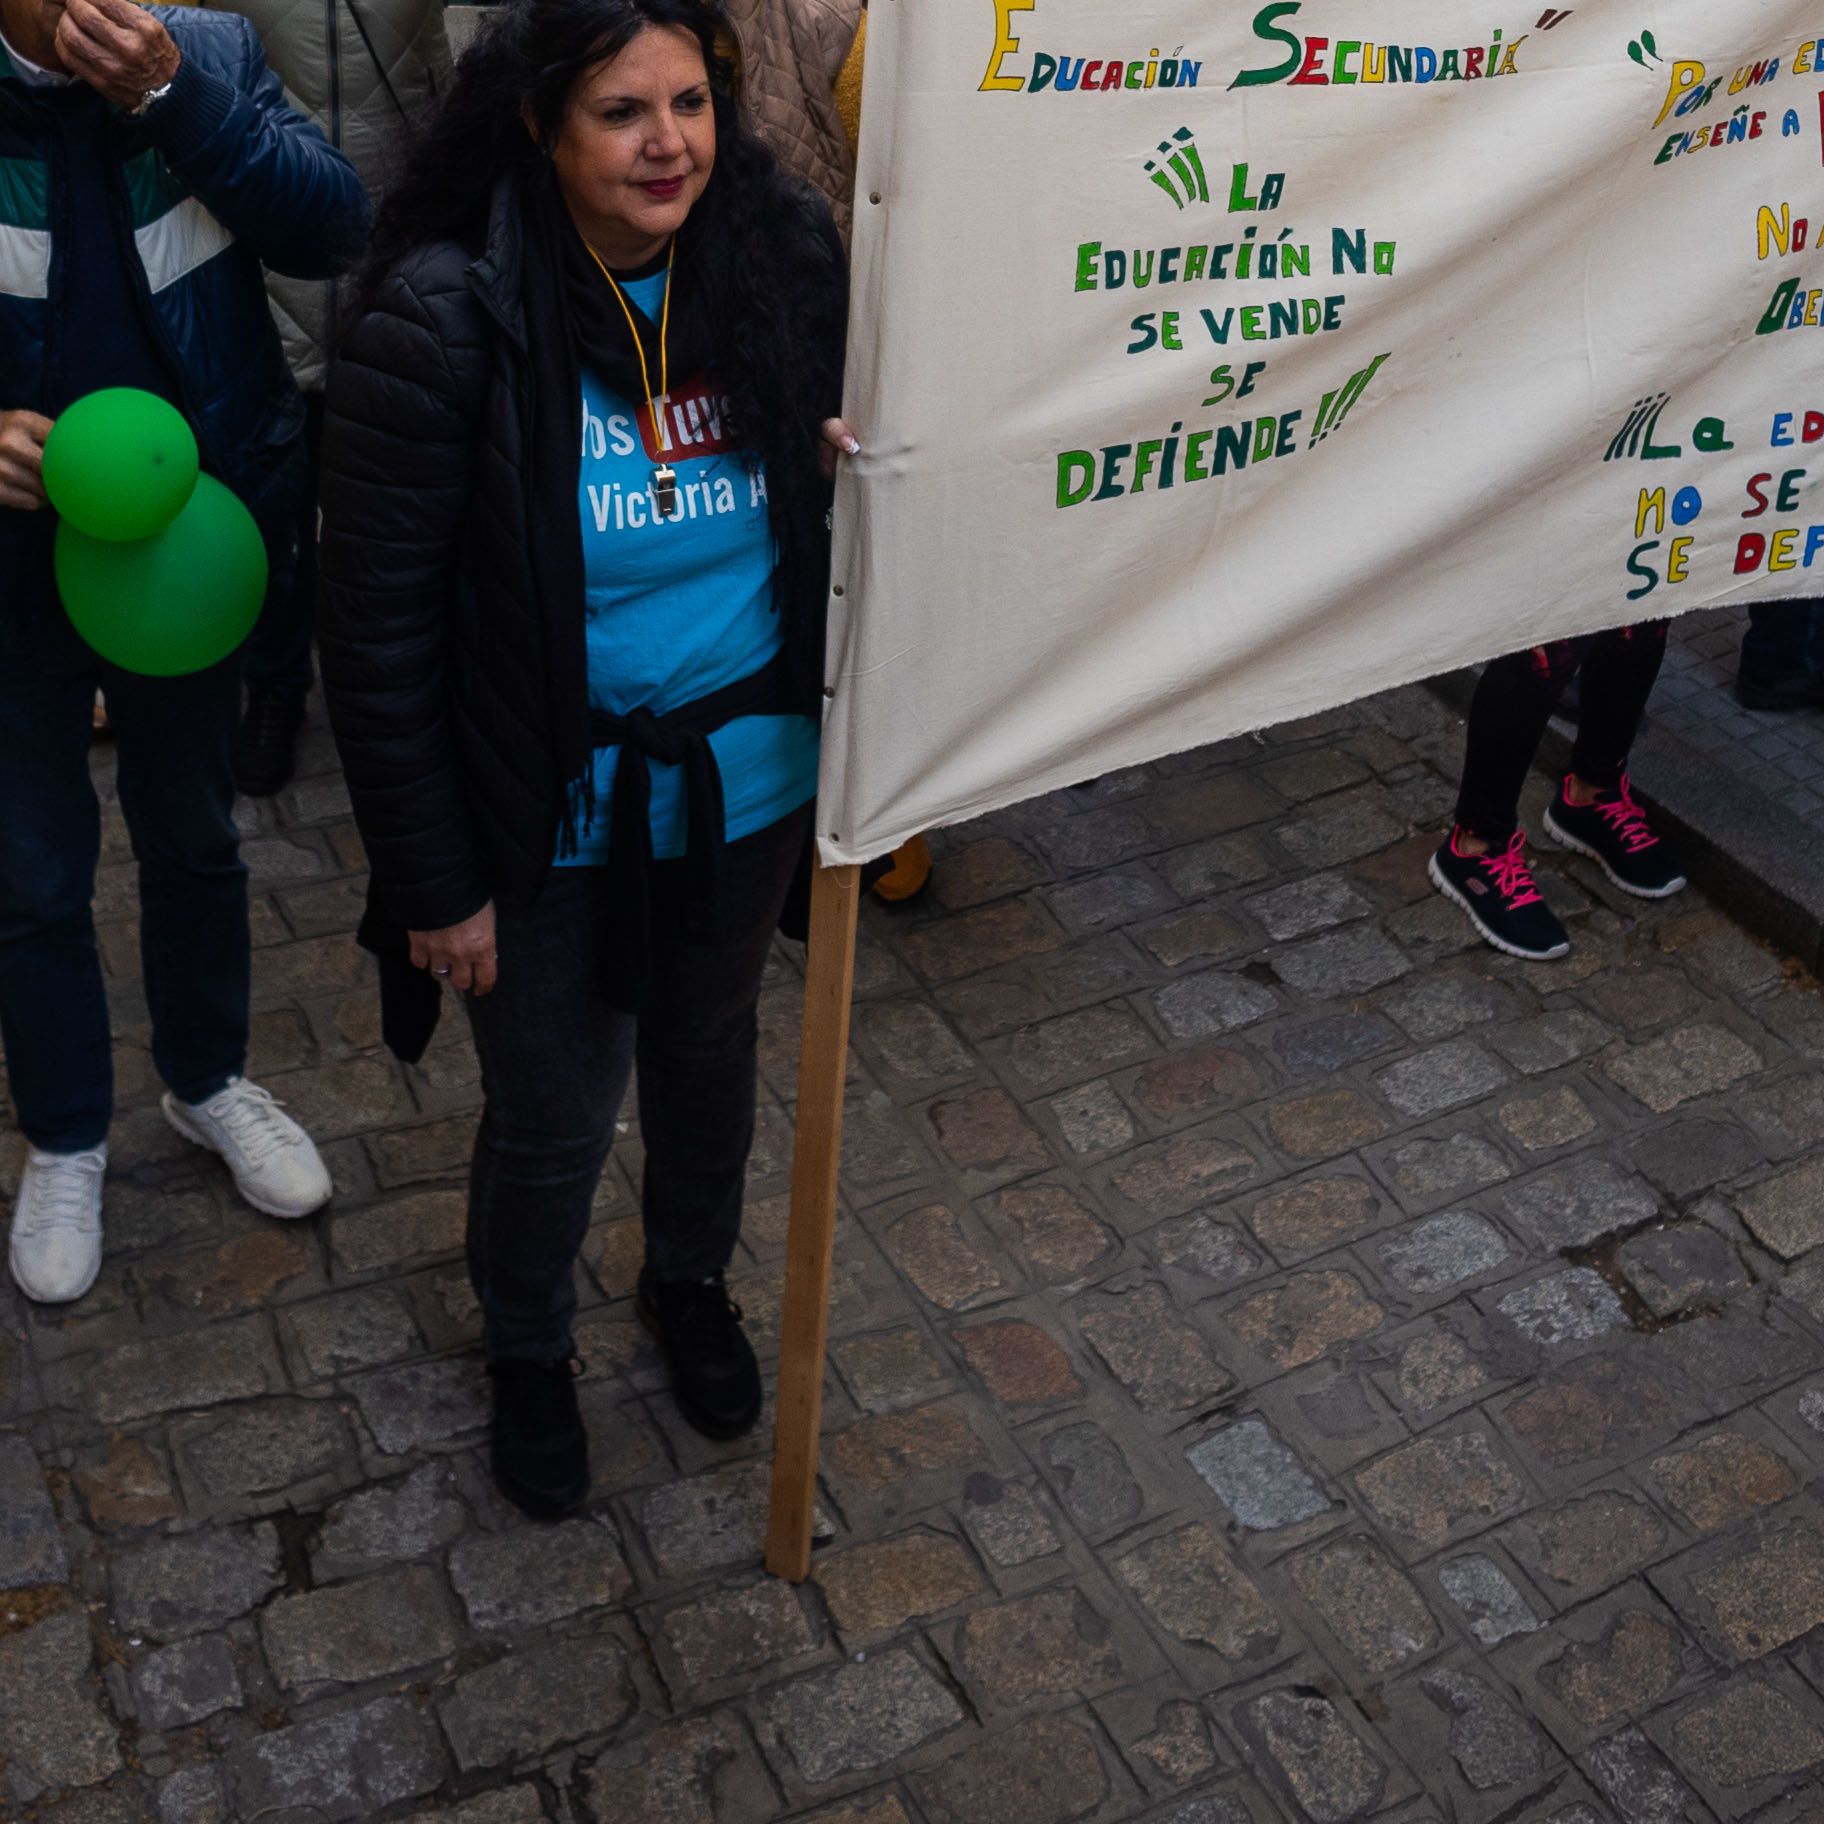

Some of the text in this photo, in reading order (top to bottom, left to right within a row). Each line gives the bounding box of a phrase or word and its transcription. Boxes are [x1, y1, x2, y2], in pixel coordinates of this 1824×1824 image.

[1727, 57, 1780, 97] UNA
[1652, 103, 1767, 166] ENSEÑE
[1782, 108, 1801, 137] A
[1074, 226, 1311, 293] EDUCACIÓN
[1126, 294, 1346, 354] SE VENDE
[1200, 360, 1266, 408] SE
[587, 470, 736, 532] Victoria
[1741, 469, 1807, 520] SE
[1626, 534, 1695, 601] SE
